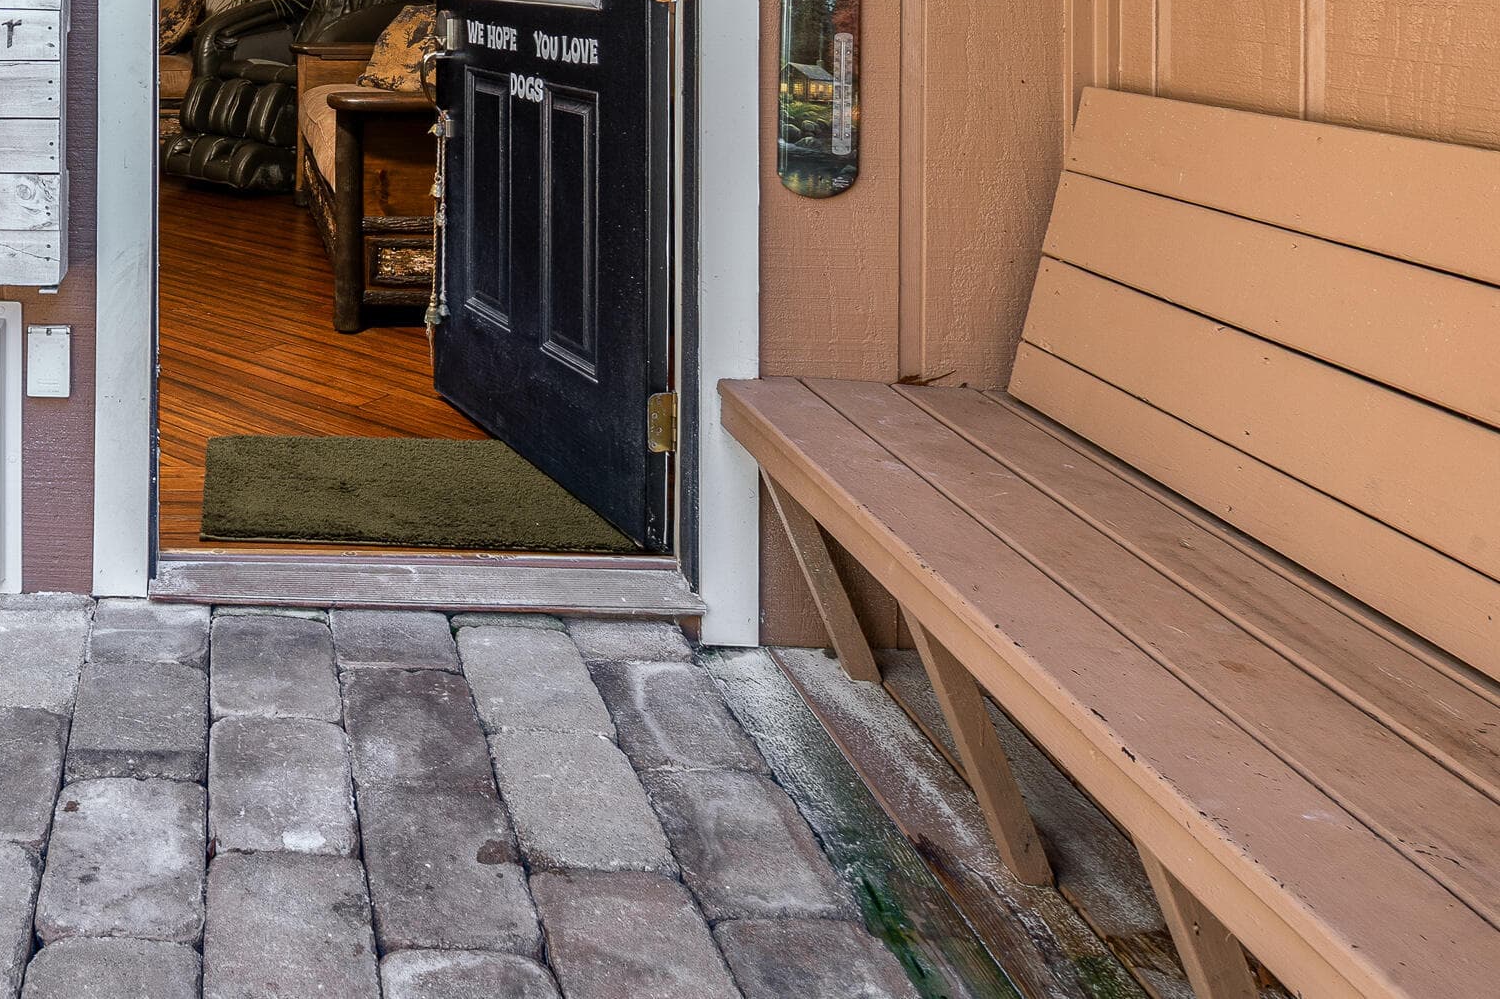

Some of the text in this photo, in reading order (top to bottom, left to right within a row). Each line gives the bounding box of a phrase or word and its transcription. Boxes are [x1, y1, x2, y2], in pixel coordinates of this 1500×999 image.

[466, 19, 598, 64] WE HOPE YOU LOVE
[510, 72, 544, 103] DOGS
